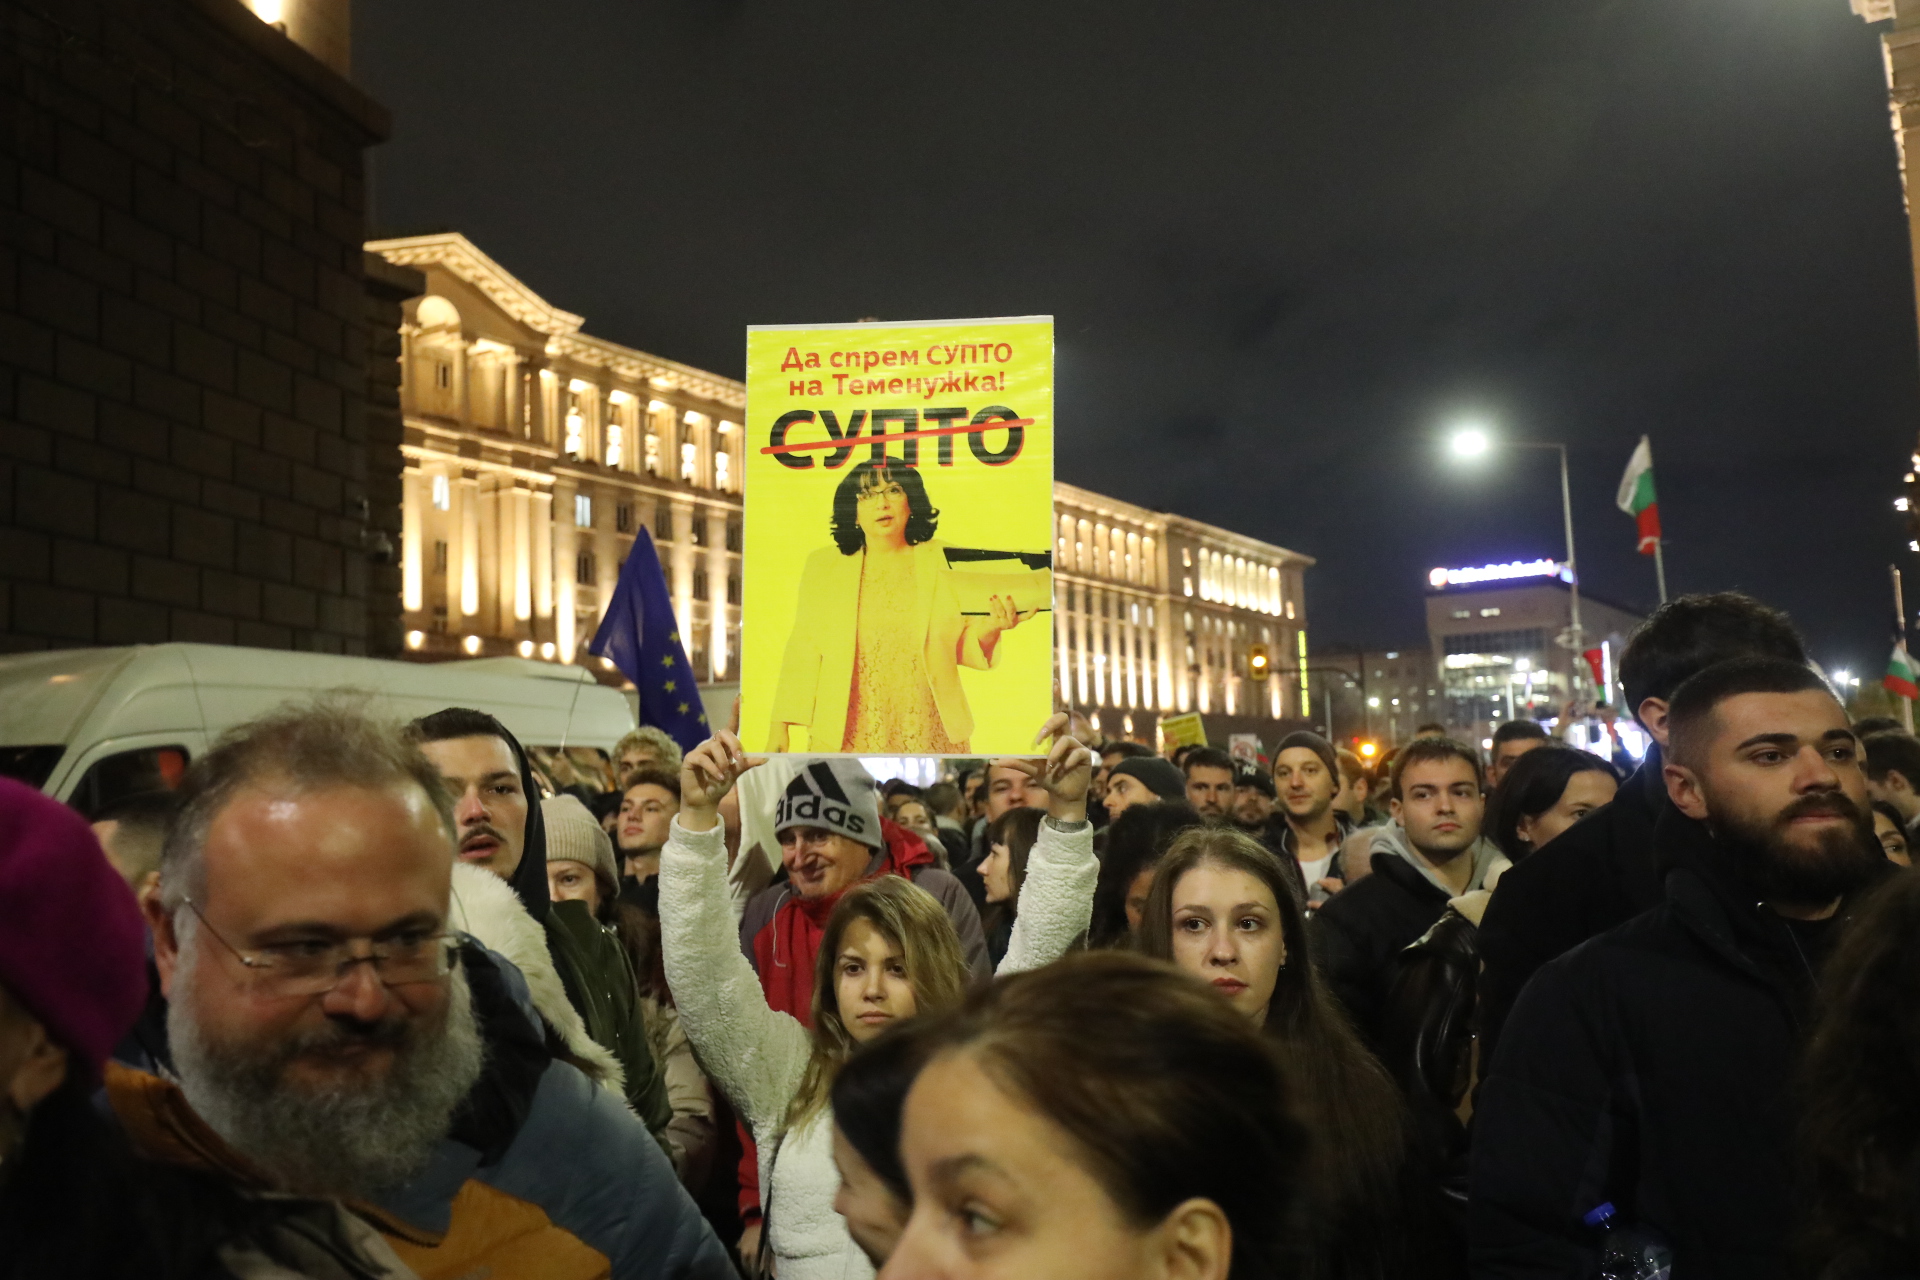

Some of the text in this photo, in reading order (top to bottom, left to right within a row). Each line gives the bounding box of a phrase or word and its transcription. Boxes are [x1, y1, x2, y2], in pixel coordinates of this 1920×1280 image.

[781, 342, 1013, 372] Да спрем СУПТО
[789, 371, 1006, 399] на Теменужка!
[769, 405, 1025, 470] СУПТО
